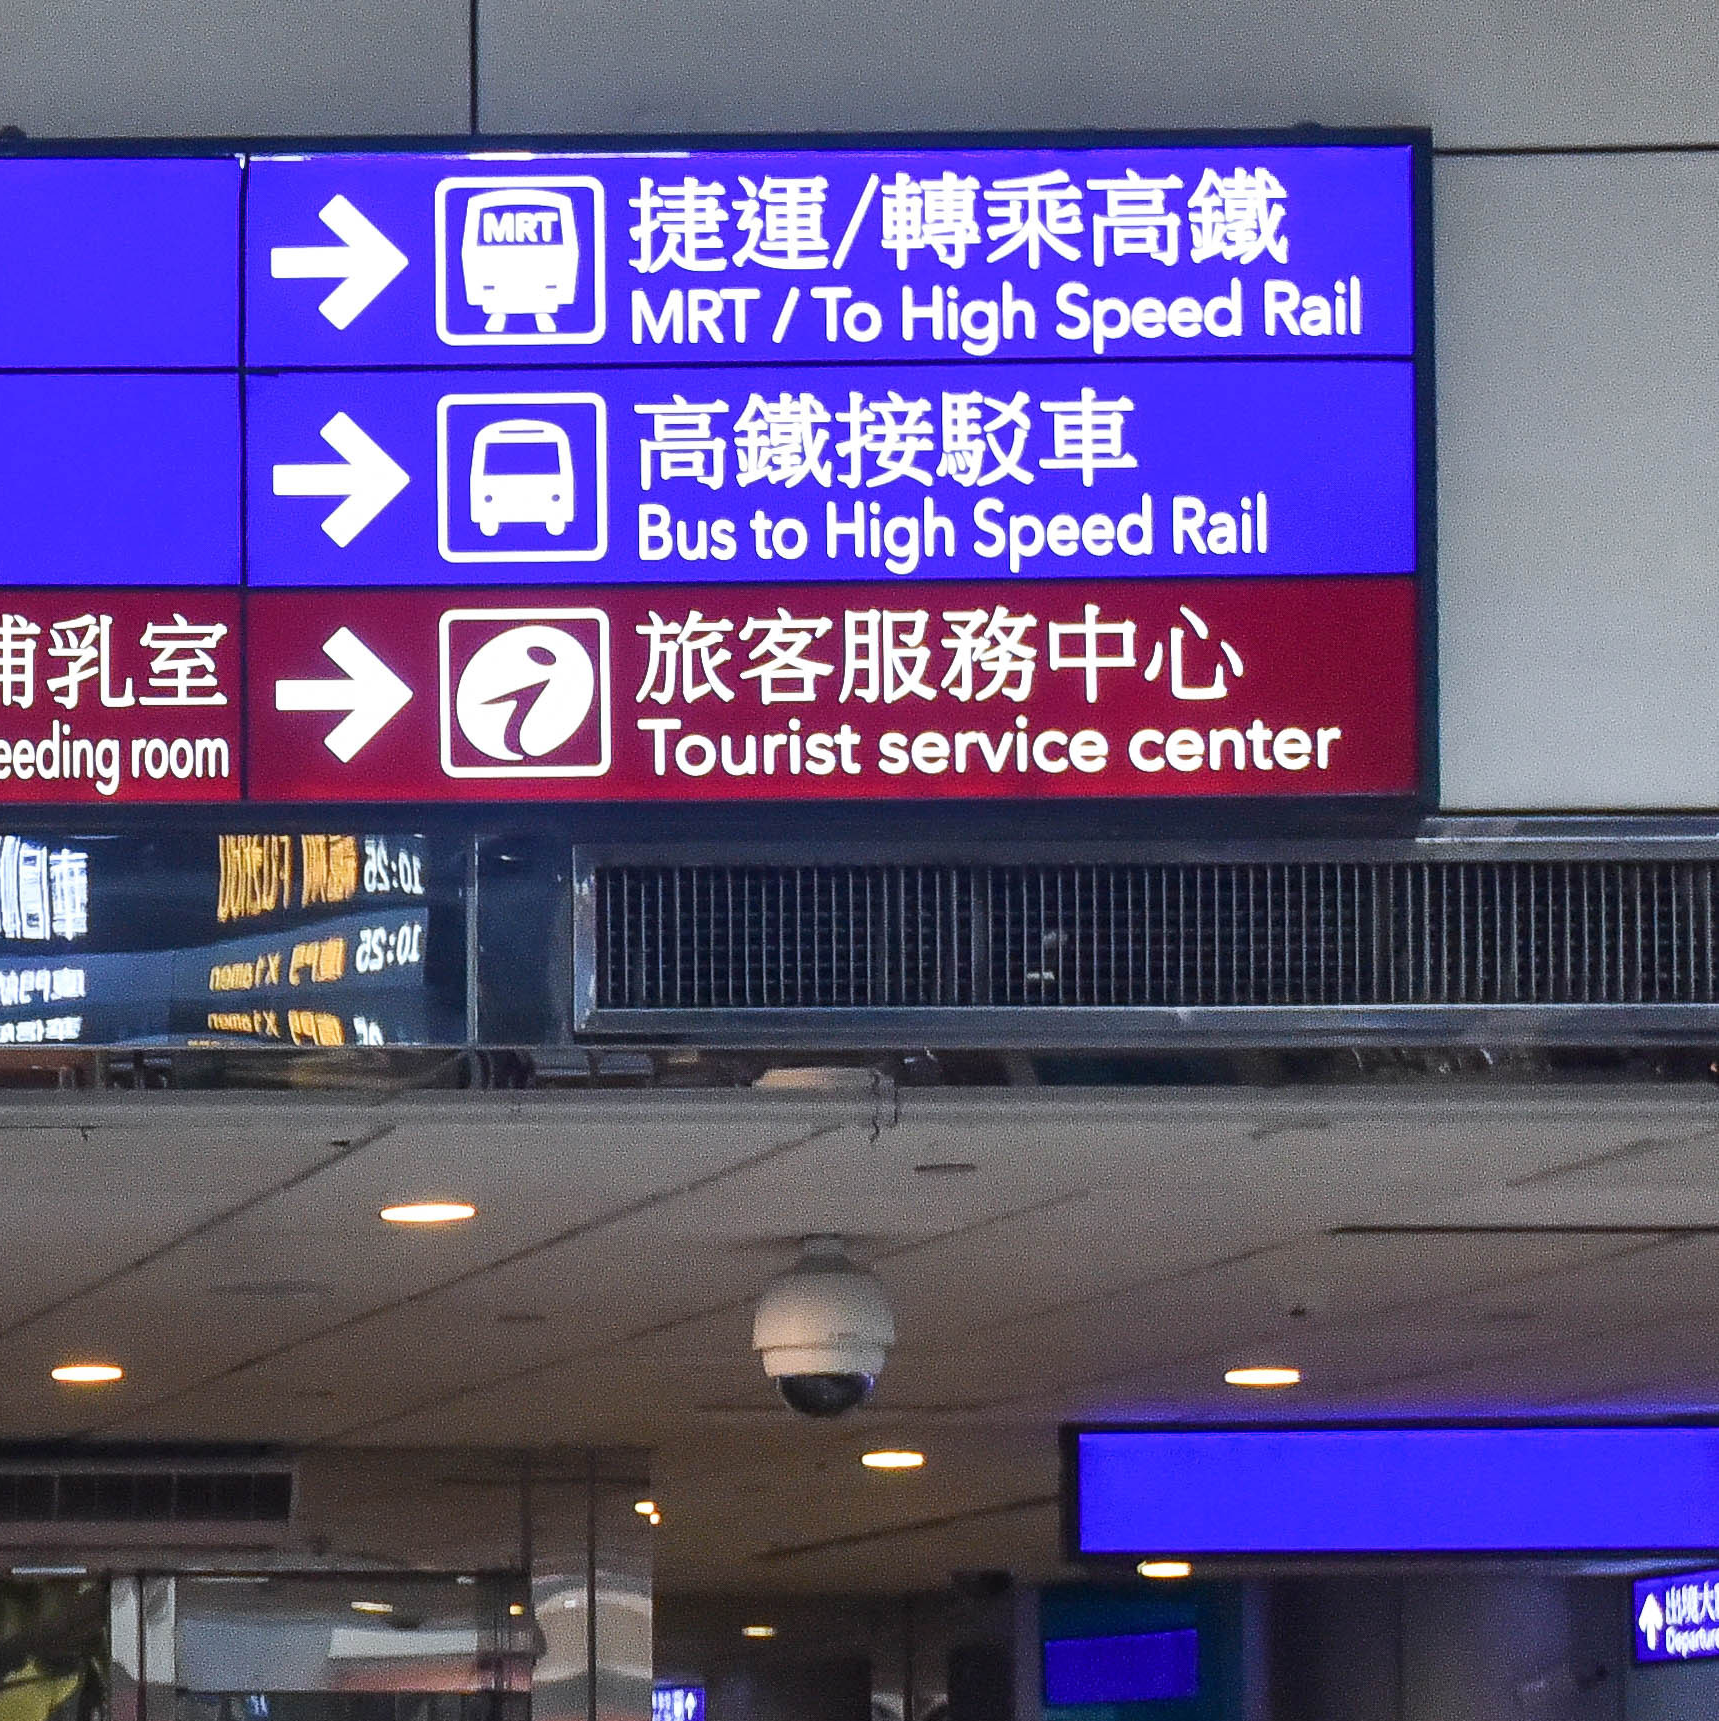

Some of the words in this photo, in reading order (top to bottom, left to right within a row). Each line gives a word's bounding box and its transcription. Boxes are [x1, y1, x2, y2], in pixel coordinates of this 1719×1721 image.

[482, 211, 560, 244] MRT
[628, 167, 1289, 271] 捷運/轉乘高鐵
[631, 287, 762, 345] MRT
[771, 286, 801, 344] /
[809, 286, 883, 343] To
[901, 279, 1037, 357] High
[1055, 276, 1244, 355] Speed
[1263, 274, 1362, 337] Rail
[633, 386, 1139, 491] 高鐵接駁車
[638, 503, 738, 561] Bus
[749, 508, 809, 560] to
[826, 495, 956, 575] High
[973, 494, 1154, 574] Speed
[1172, 490, 1268, 555] Rail
[635, 603, 1244, 706] 旅客服務中心
[131, 737, 230, 780] room
[636, 717, 862, 777] Tourist
[878, 715, 1109, 775] service
[1128, 718, 1342, 773] center
